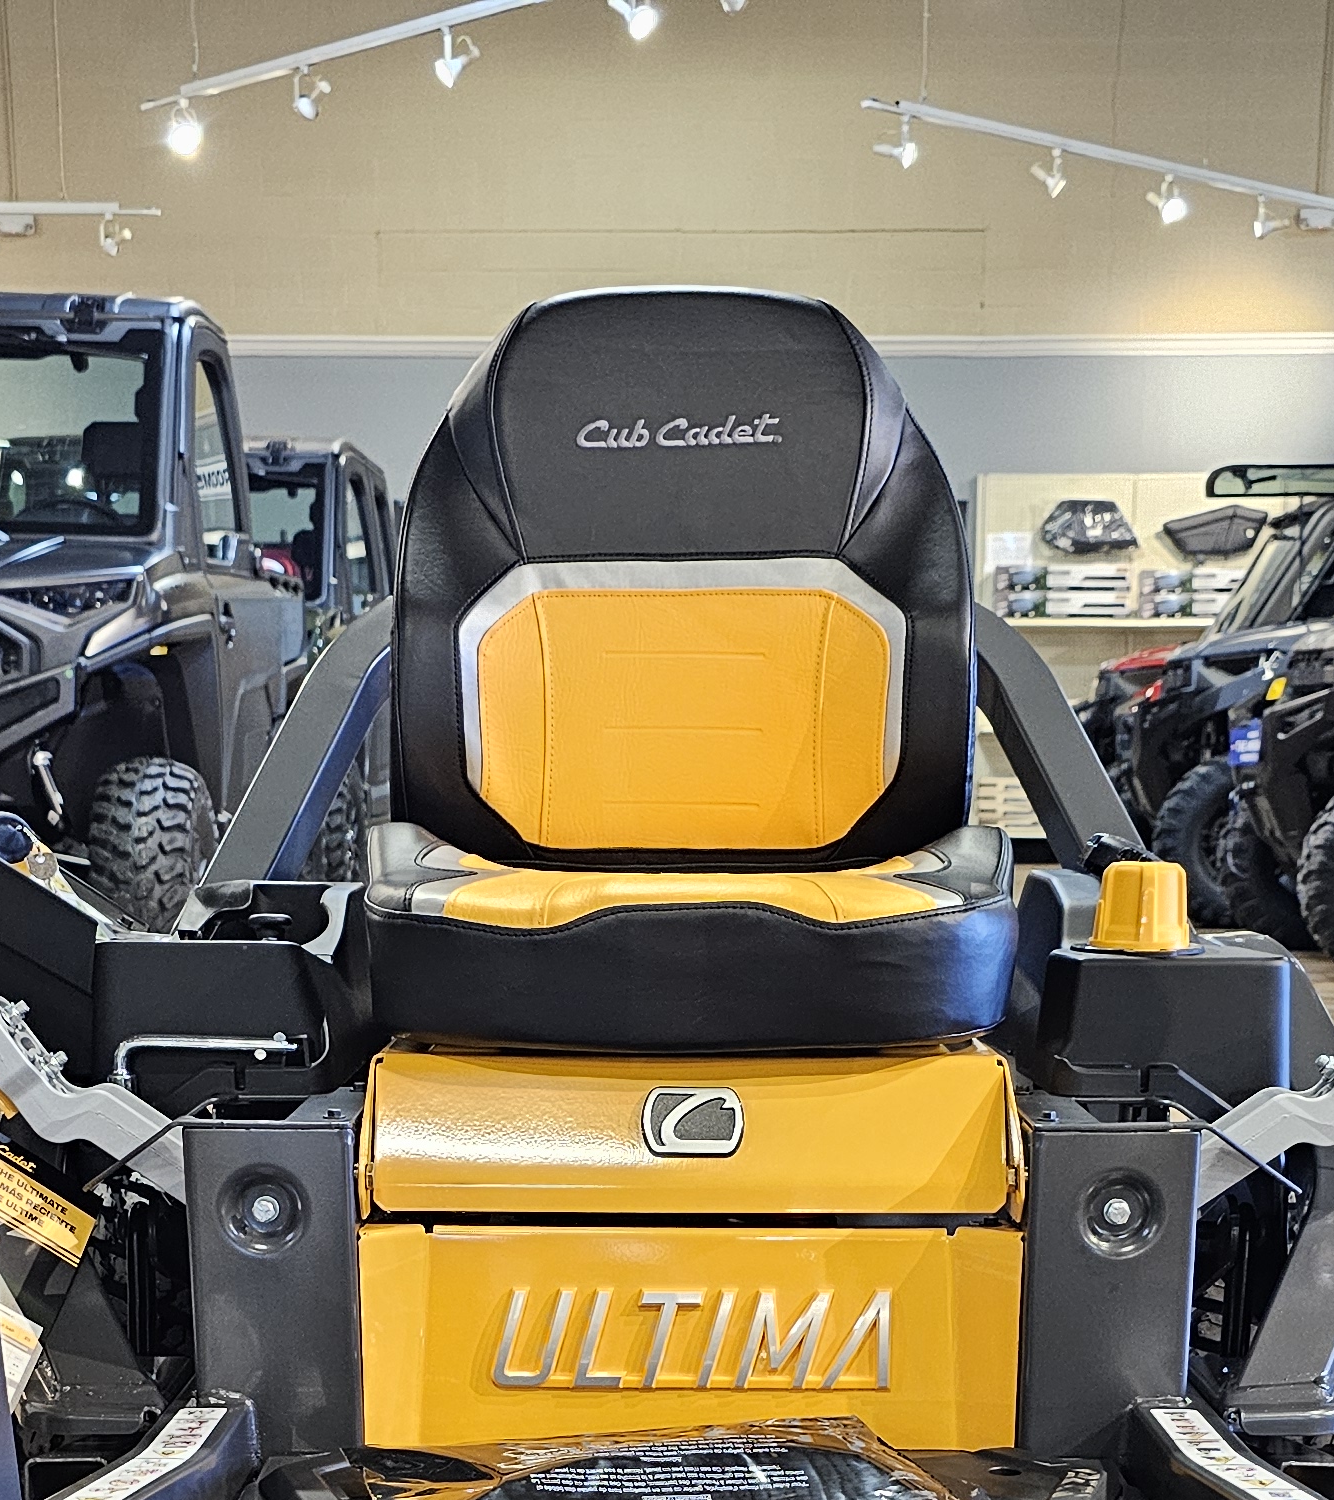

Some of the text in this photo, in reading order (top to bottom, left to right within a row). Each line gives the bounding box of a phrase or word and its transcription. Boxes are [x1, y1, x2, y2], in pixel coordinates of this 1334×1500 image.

[576, 413, 781, 448] Cub Cadet
[0, 1180, 24, 1201] MÁS
[25, 1198, 77, 1235] RECIENTE
[5, 1200, 45, 1228] ULTIME
[17, 1178, 69, 1215] ULTIMATE
[492, 1288, 892, 1390] ULTIMA
